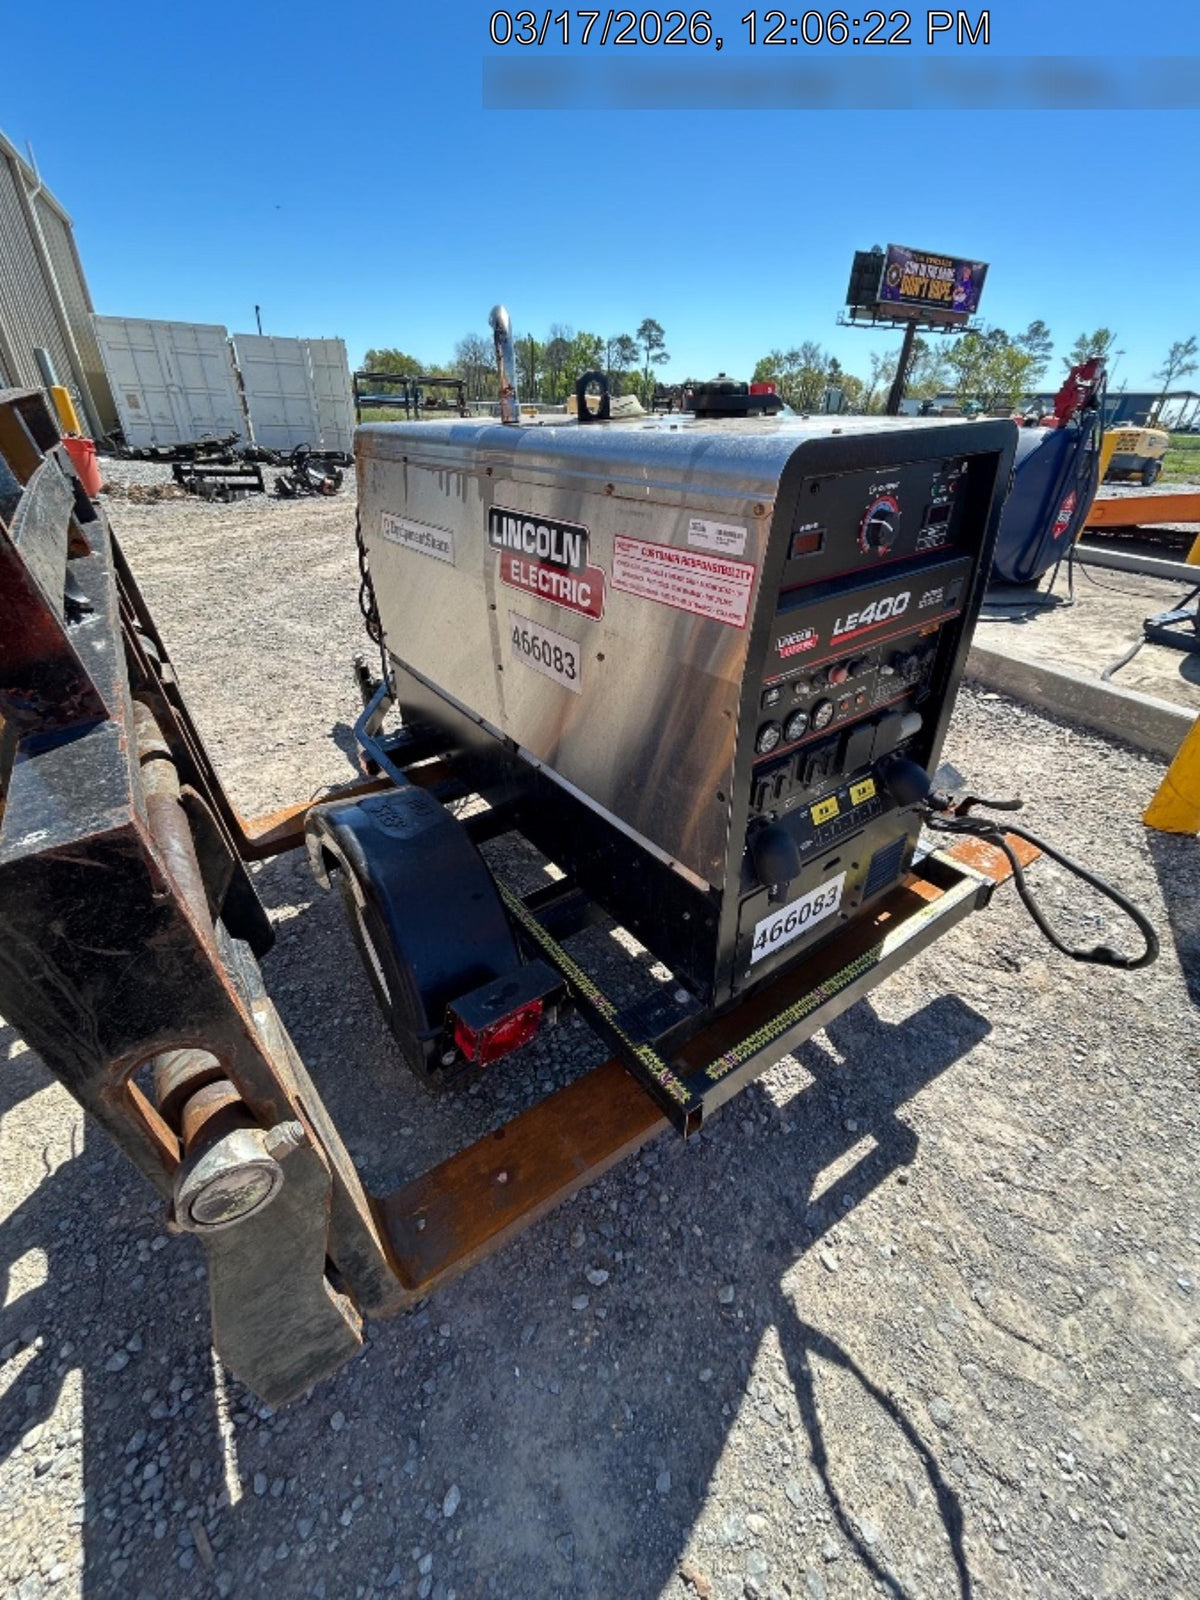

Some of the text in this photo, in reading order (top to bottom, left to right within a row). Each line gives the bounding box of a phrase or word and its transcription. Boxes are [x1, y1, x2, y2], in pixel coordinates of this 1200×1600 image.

[492, 514, 581, 568] LINCOLN
[641, 547, 680, 565] CUSTOMER
[511, 559, 591, 607] ELECTRIC
[833, 591, 911, 636] LE400
[512, 625, 577, 680] 466083
[753, 884, 839, 950] 466083
